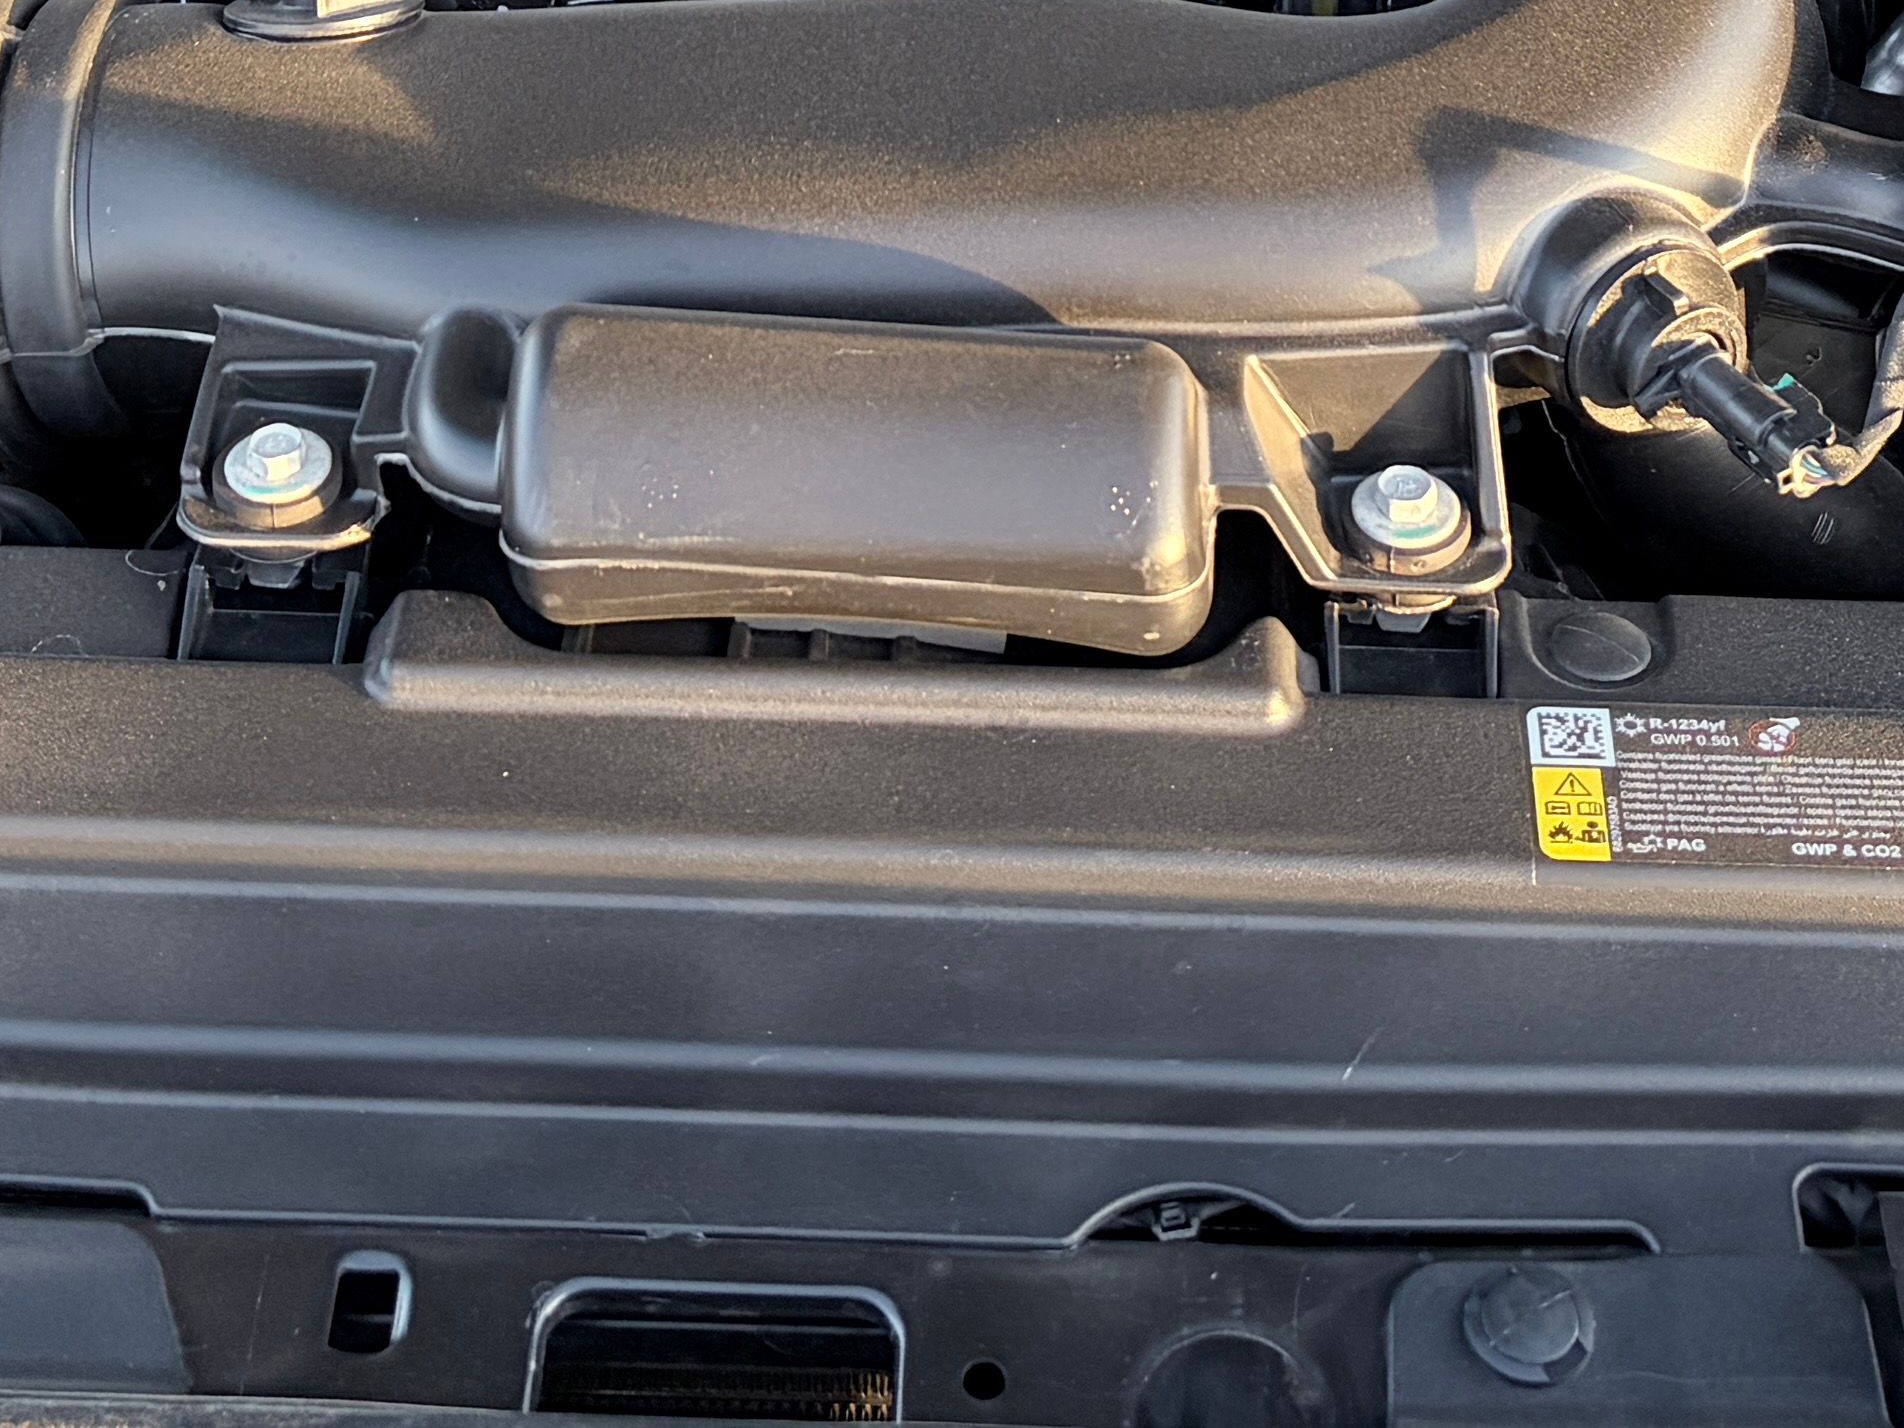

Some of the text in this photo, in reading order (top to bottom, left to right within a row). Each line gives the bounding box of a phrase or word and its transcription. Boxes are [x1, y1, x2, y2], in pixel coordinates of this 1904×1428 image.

[1649, 717, 1727, 733] R-1234yf
[1650, 733, 1692, 745] GWP
[1666, 838, 1706, 852] PAG
[1791, 842, 1837, 855] GWP
[1842, 843, 1857, 857] &
[1861, 844, 1902, 858] CO2
